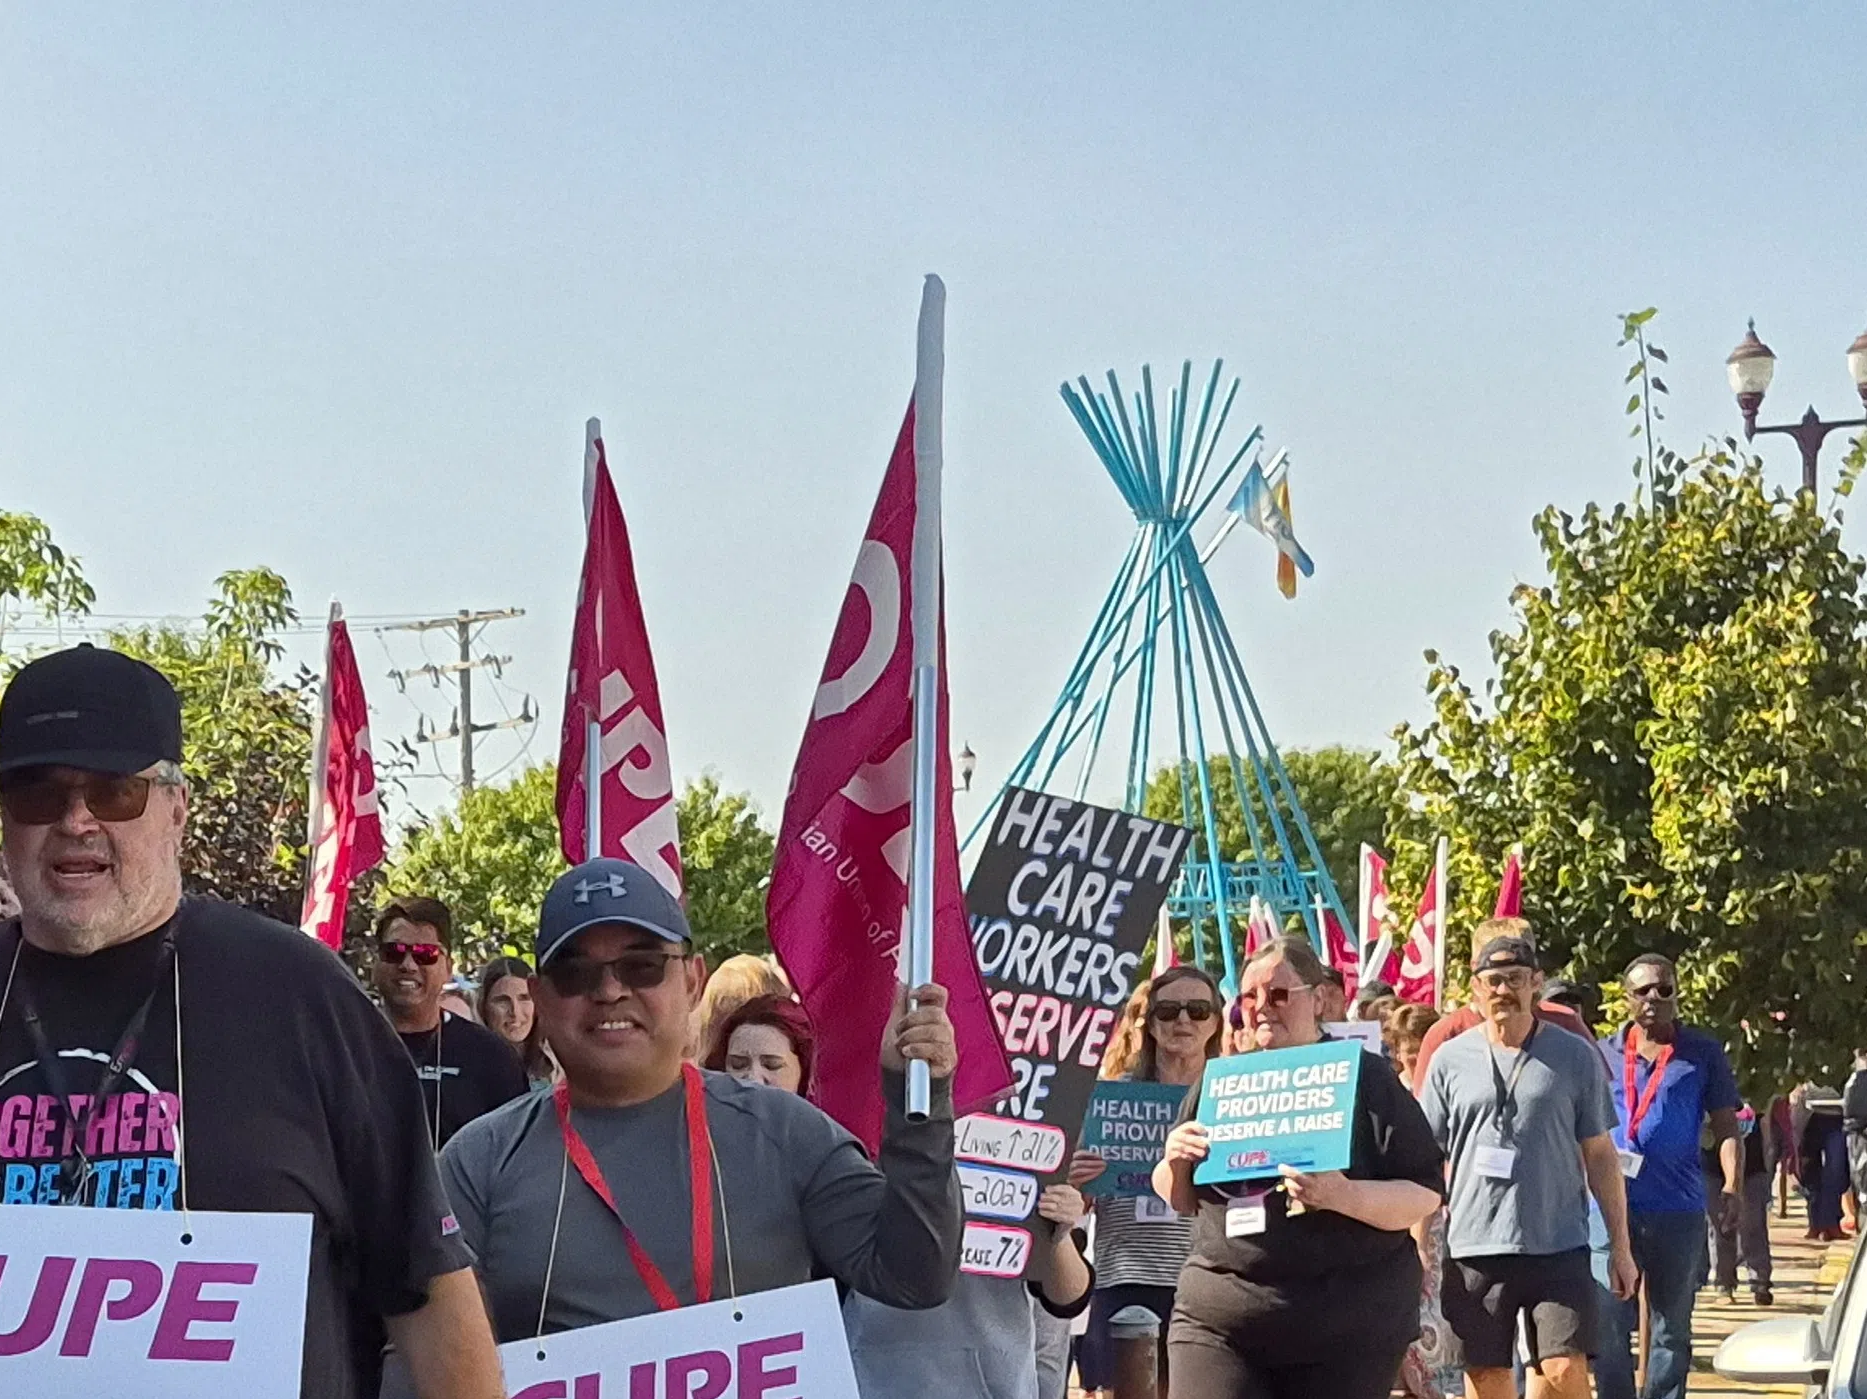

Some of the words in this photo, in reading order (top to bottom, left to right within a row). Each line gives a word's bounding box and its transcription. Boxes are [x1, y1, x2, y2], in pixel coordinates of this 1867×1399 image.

[997, 790, 1185, 885] HEALTH
[1008, 860, 1133, 937] CARE
[986, 988, 1116, 1067] SERVE
[995, 1058, 1056, 1120] RE
[1209, 1069, 1289, 1098] HEALTH
[1292, 1061, 1351, 1088] CARE
[1093, 1099, 1171, 1121] HEALTH
[1215, 1087, 1335, 1120] PROVIDERS
[1101, 1120, 1168, 1142] PROVI
[1206, 1119, 1277, 1142] DESERVE
[1278, 1117, 1290, 1134] A
[1294, 1111, 1345, 1133] RAISE
[996, 1236, 1025, 1268] 7%
